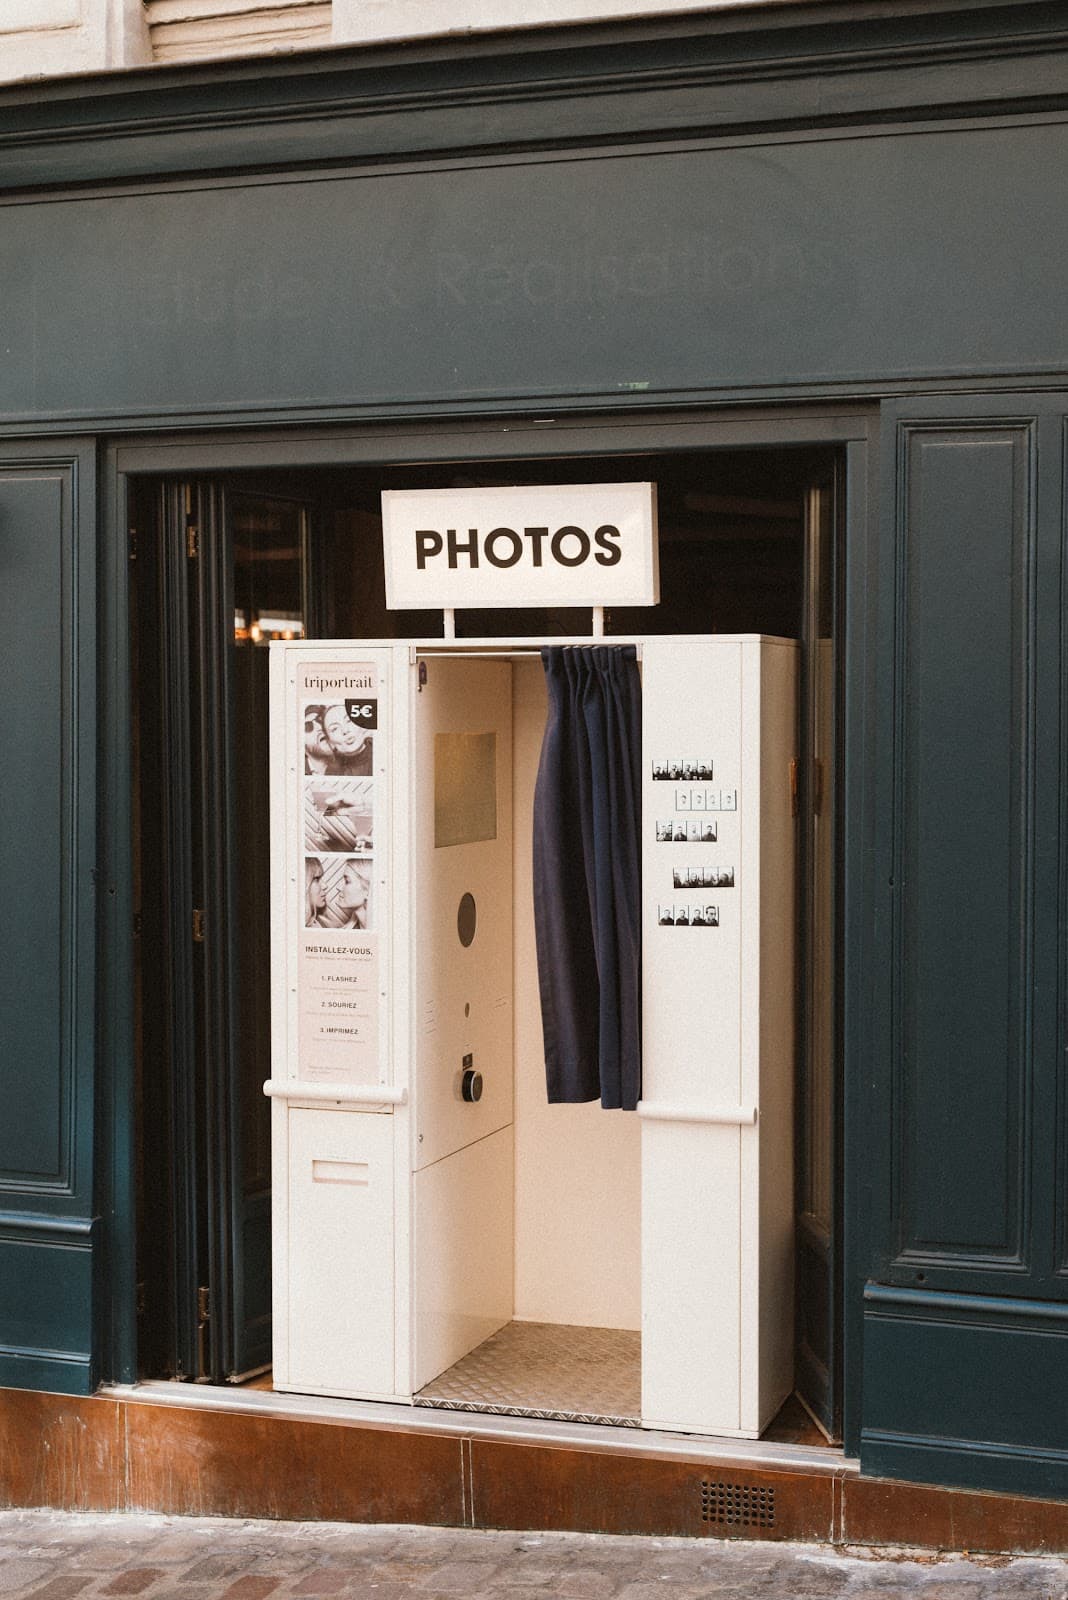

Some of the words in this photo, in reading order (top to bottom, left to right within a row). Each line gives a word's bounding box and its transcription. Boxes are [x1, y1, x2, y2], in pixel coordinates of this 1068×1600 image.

[415, 524, 622, 570] PHOTOS
[304, 676, 373, 692] triportrait
[350, 704, 373, 718] 5€
[305, 945, 373, 956] INSTALLEZ-VOUS,
[327, 975, 358, 983] FLASHEZ
[327, 1001, 358, 1009] SOURIEZ
[326, 1027, 359, 1035] IMPRIMEZ
